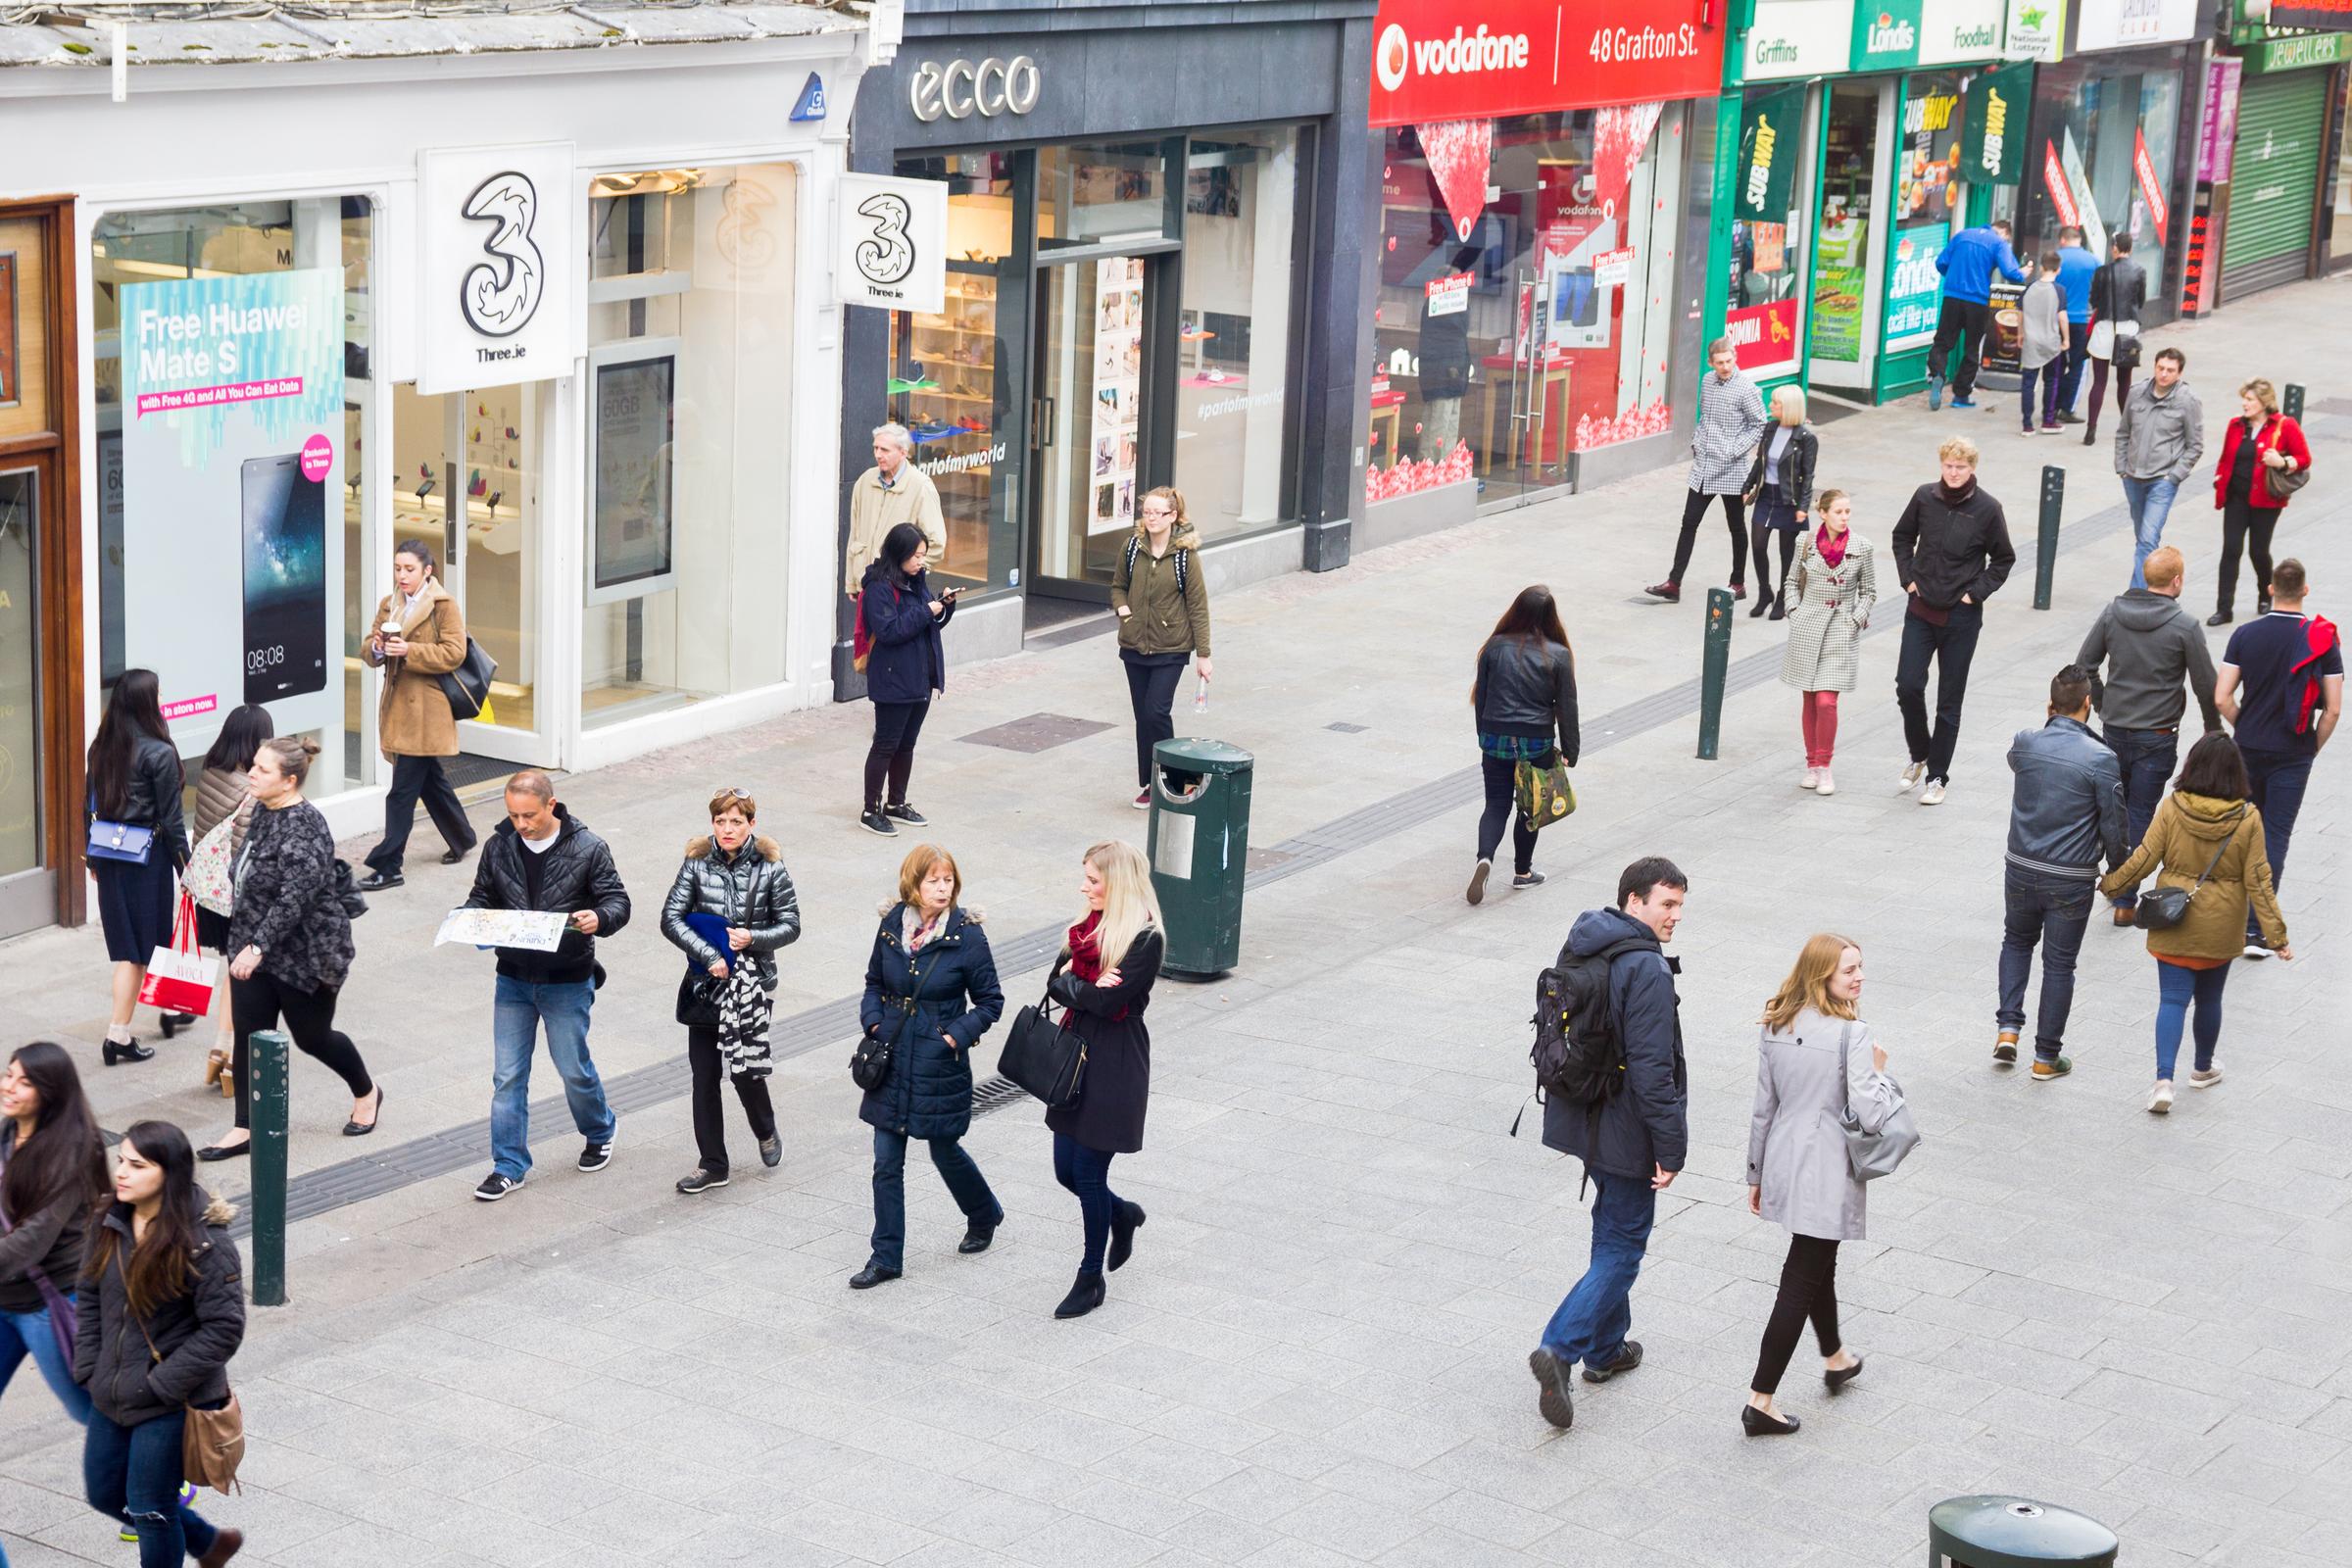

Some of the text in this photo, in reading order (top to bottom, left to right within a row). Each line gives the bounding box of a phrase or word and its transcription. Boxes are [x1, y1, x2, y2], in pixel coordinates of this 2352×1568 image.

[1413, 24, 1530, 75] vodafone
[1589, 23, 1698, 63] 48 Grafton St.
[1755, 38, 1798, 65] Griffins
[1868, 20, 1915, 53] Londis
[1954, 24, 1995, 50] Foodhall
[2011, 33, 2050, 43] National
[2013, 42, 2047, 55] Lottery
[910, 56, 1041, 122] ecco
[1982, 86, 2008, 176] SUBWAY
[1746, 113, 1777, 213] SUBWAY
[1557, 205, 1602, 216] vodafon
[856, 193, 915, 284] 3
[1429, 280, 1445, 296] Free
[140, 297, 310, 344] Free Huawei
[1725, 316, 1761, 347] SOMNIA
[140, 340, 236, 383] Mate S
[475, 344, 527, 364] Three.ie
[141, 380, 300, 410] with Free 4G and All You Can Eat Data
[603, 396, 641, 417] 60GB
[1198, 386, 1285, 422] #partofmyworld
[913, 443, 1006, 476] artofmyworld
[248, 645, 284, 669] 08:08
[173, 703, 194, 715] store
[195, 699, 214, 711] now.
